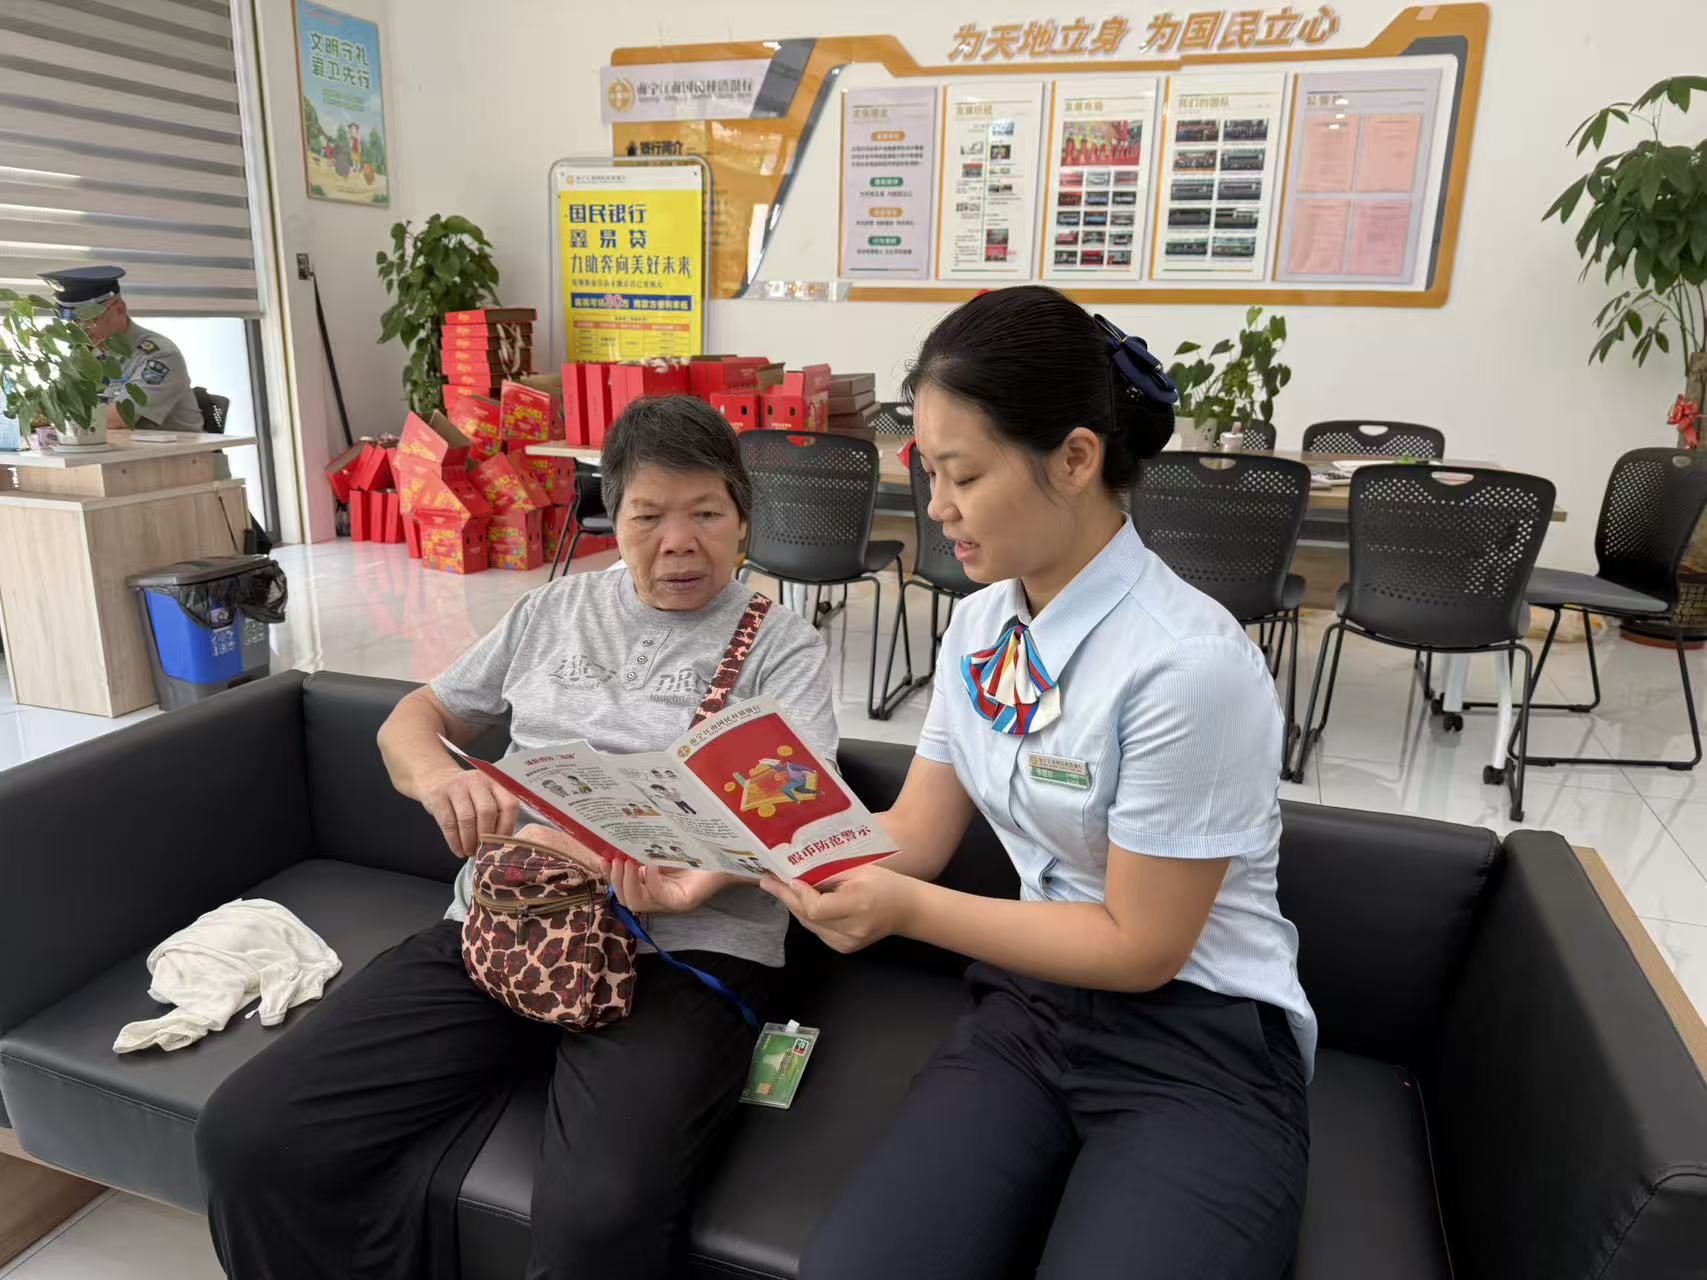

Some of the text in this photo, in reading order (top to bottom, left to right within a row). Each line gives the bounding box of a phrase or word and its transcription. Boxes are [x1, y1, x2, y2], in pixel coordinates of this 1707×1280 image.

[310, 32, 369, 67] 文明守礼
[947, 3, 1341, 61] 为天地立身 为国民立心
[569, 203, 646, 224] 国民银行
[786, 824, 873, 867] 假币防范警示
